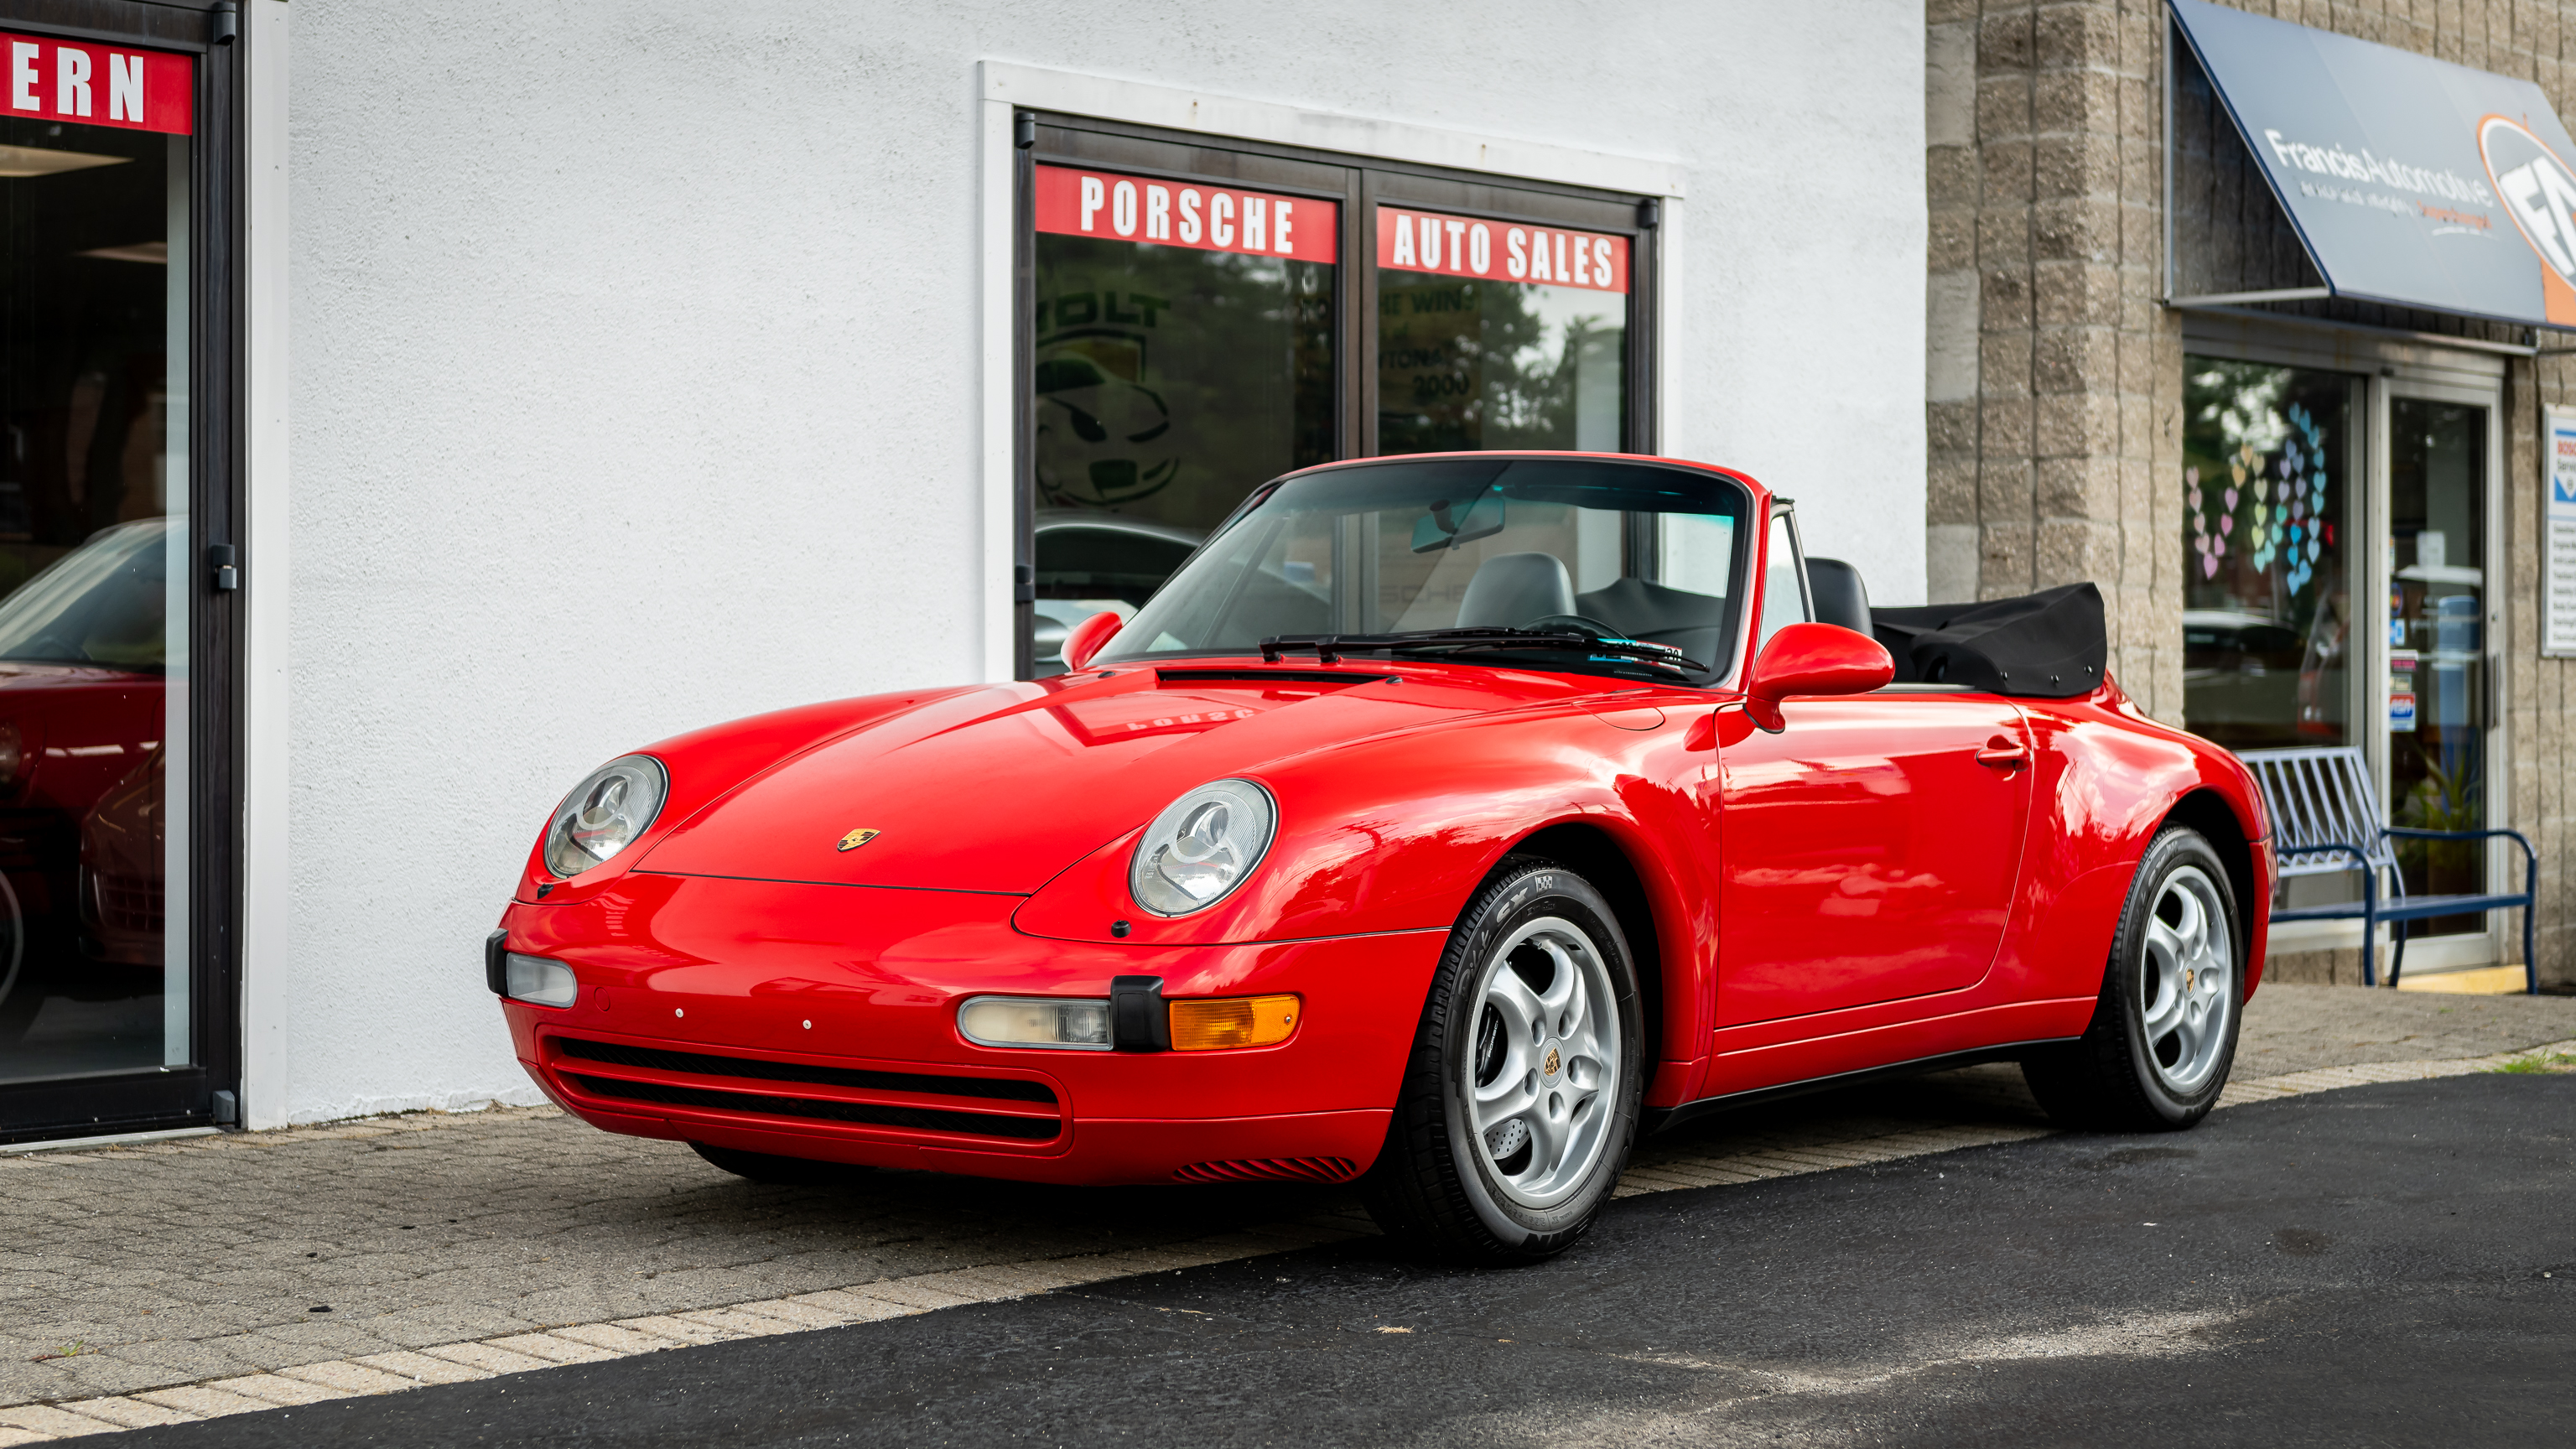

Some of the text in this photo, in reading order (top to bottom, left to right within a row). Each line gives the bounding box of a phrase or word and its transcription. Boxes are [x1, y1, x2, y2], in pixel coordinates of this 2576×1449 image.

[12, 42, 144, 123] ERN
[1081, 175, 1294, 255] PORSCHE
[1393, 214, 1614, 288] AUTO SALES
